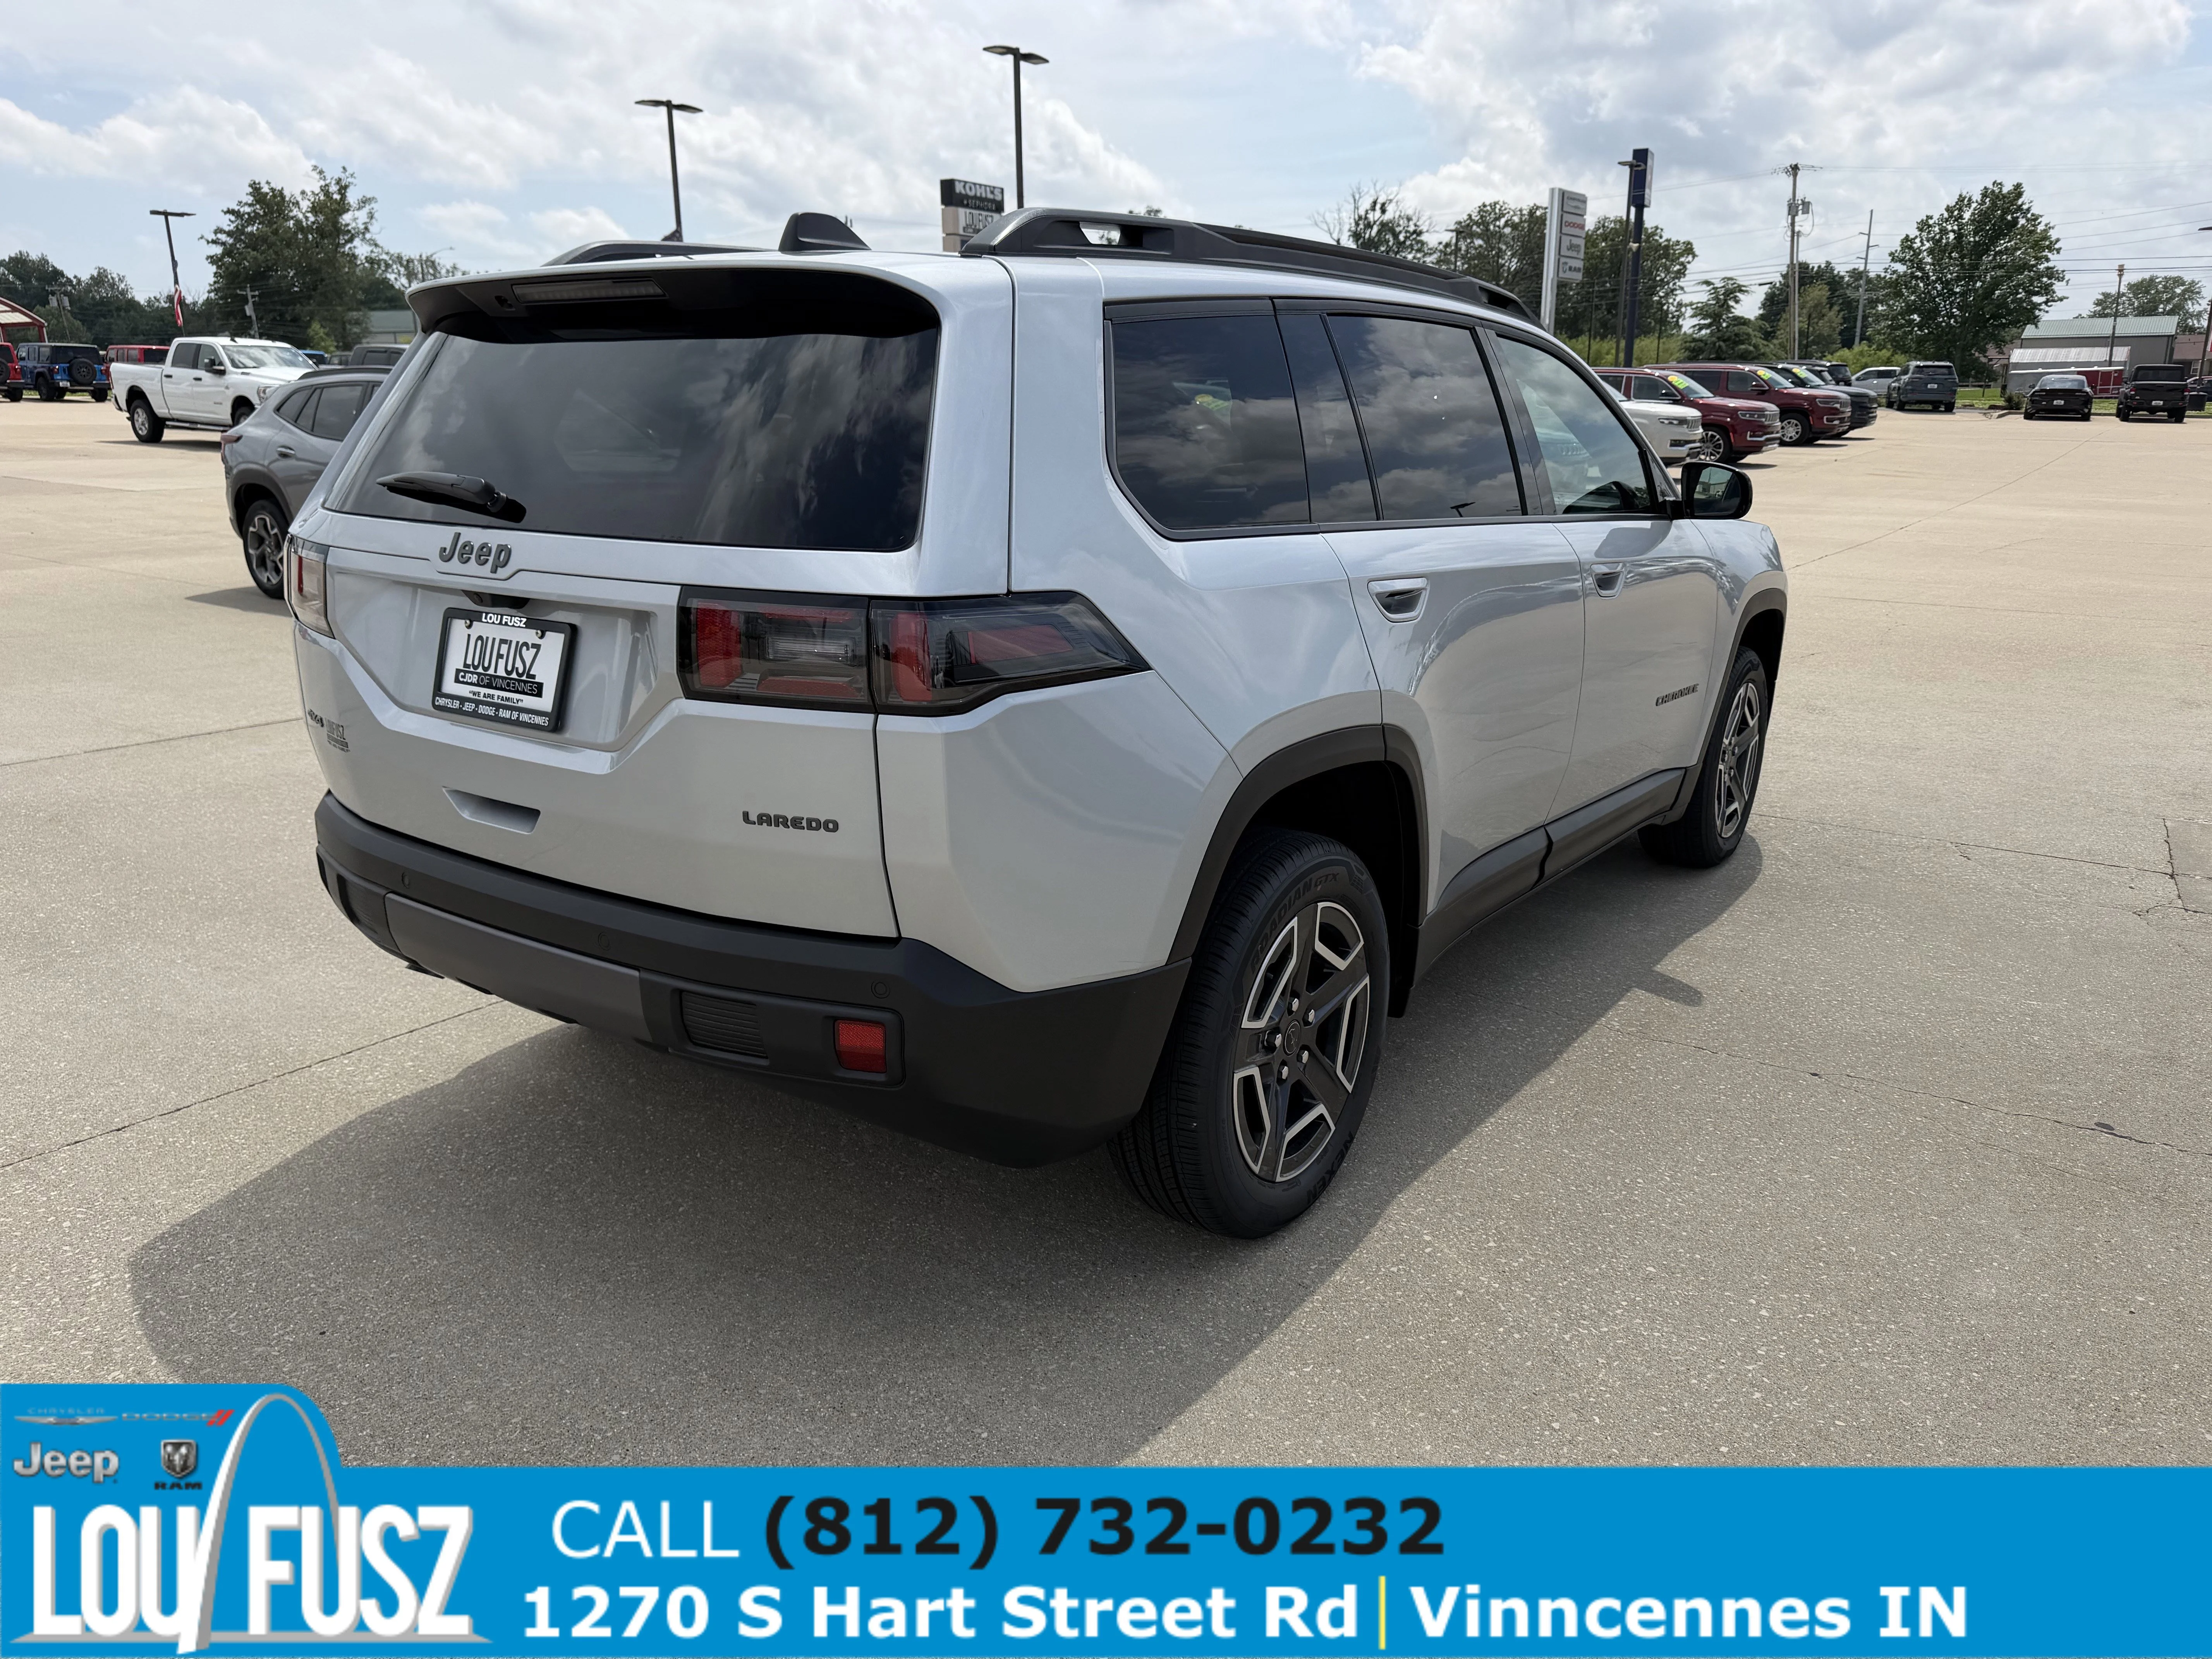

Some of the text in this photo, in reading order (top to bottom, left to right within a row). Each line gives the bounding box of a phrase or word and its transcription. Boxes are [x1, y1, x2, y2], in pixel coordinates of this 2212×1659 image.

[955, 180, 1003, 201] KOHL'S
[1566, 239, 1581, 255] Jeep
[439, 532, 512, 574] Jeep
[482, 613, 527, 627] LOU FUSZ
[463, 634, 541, 680] LOU FUSZ
[459, 672, 538, 694] CJDR OF VINCENNES
[1656, 683, 1699, 706] CHEROKEE
[435, 697, 549, 726] CHRYSLER JEEP DODGE RAM OF VINCENNES
[742, 811, 839, 833] LAREDO
[1250, 872, 1339, 974] ROADIAN GTX
[1307, 1131, 1354, 1205] NEXEN
